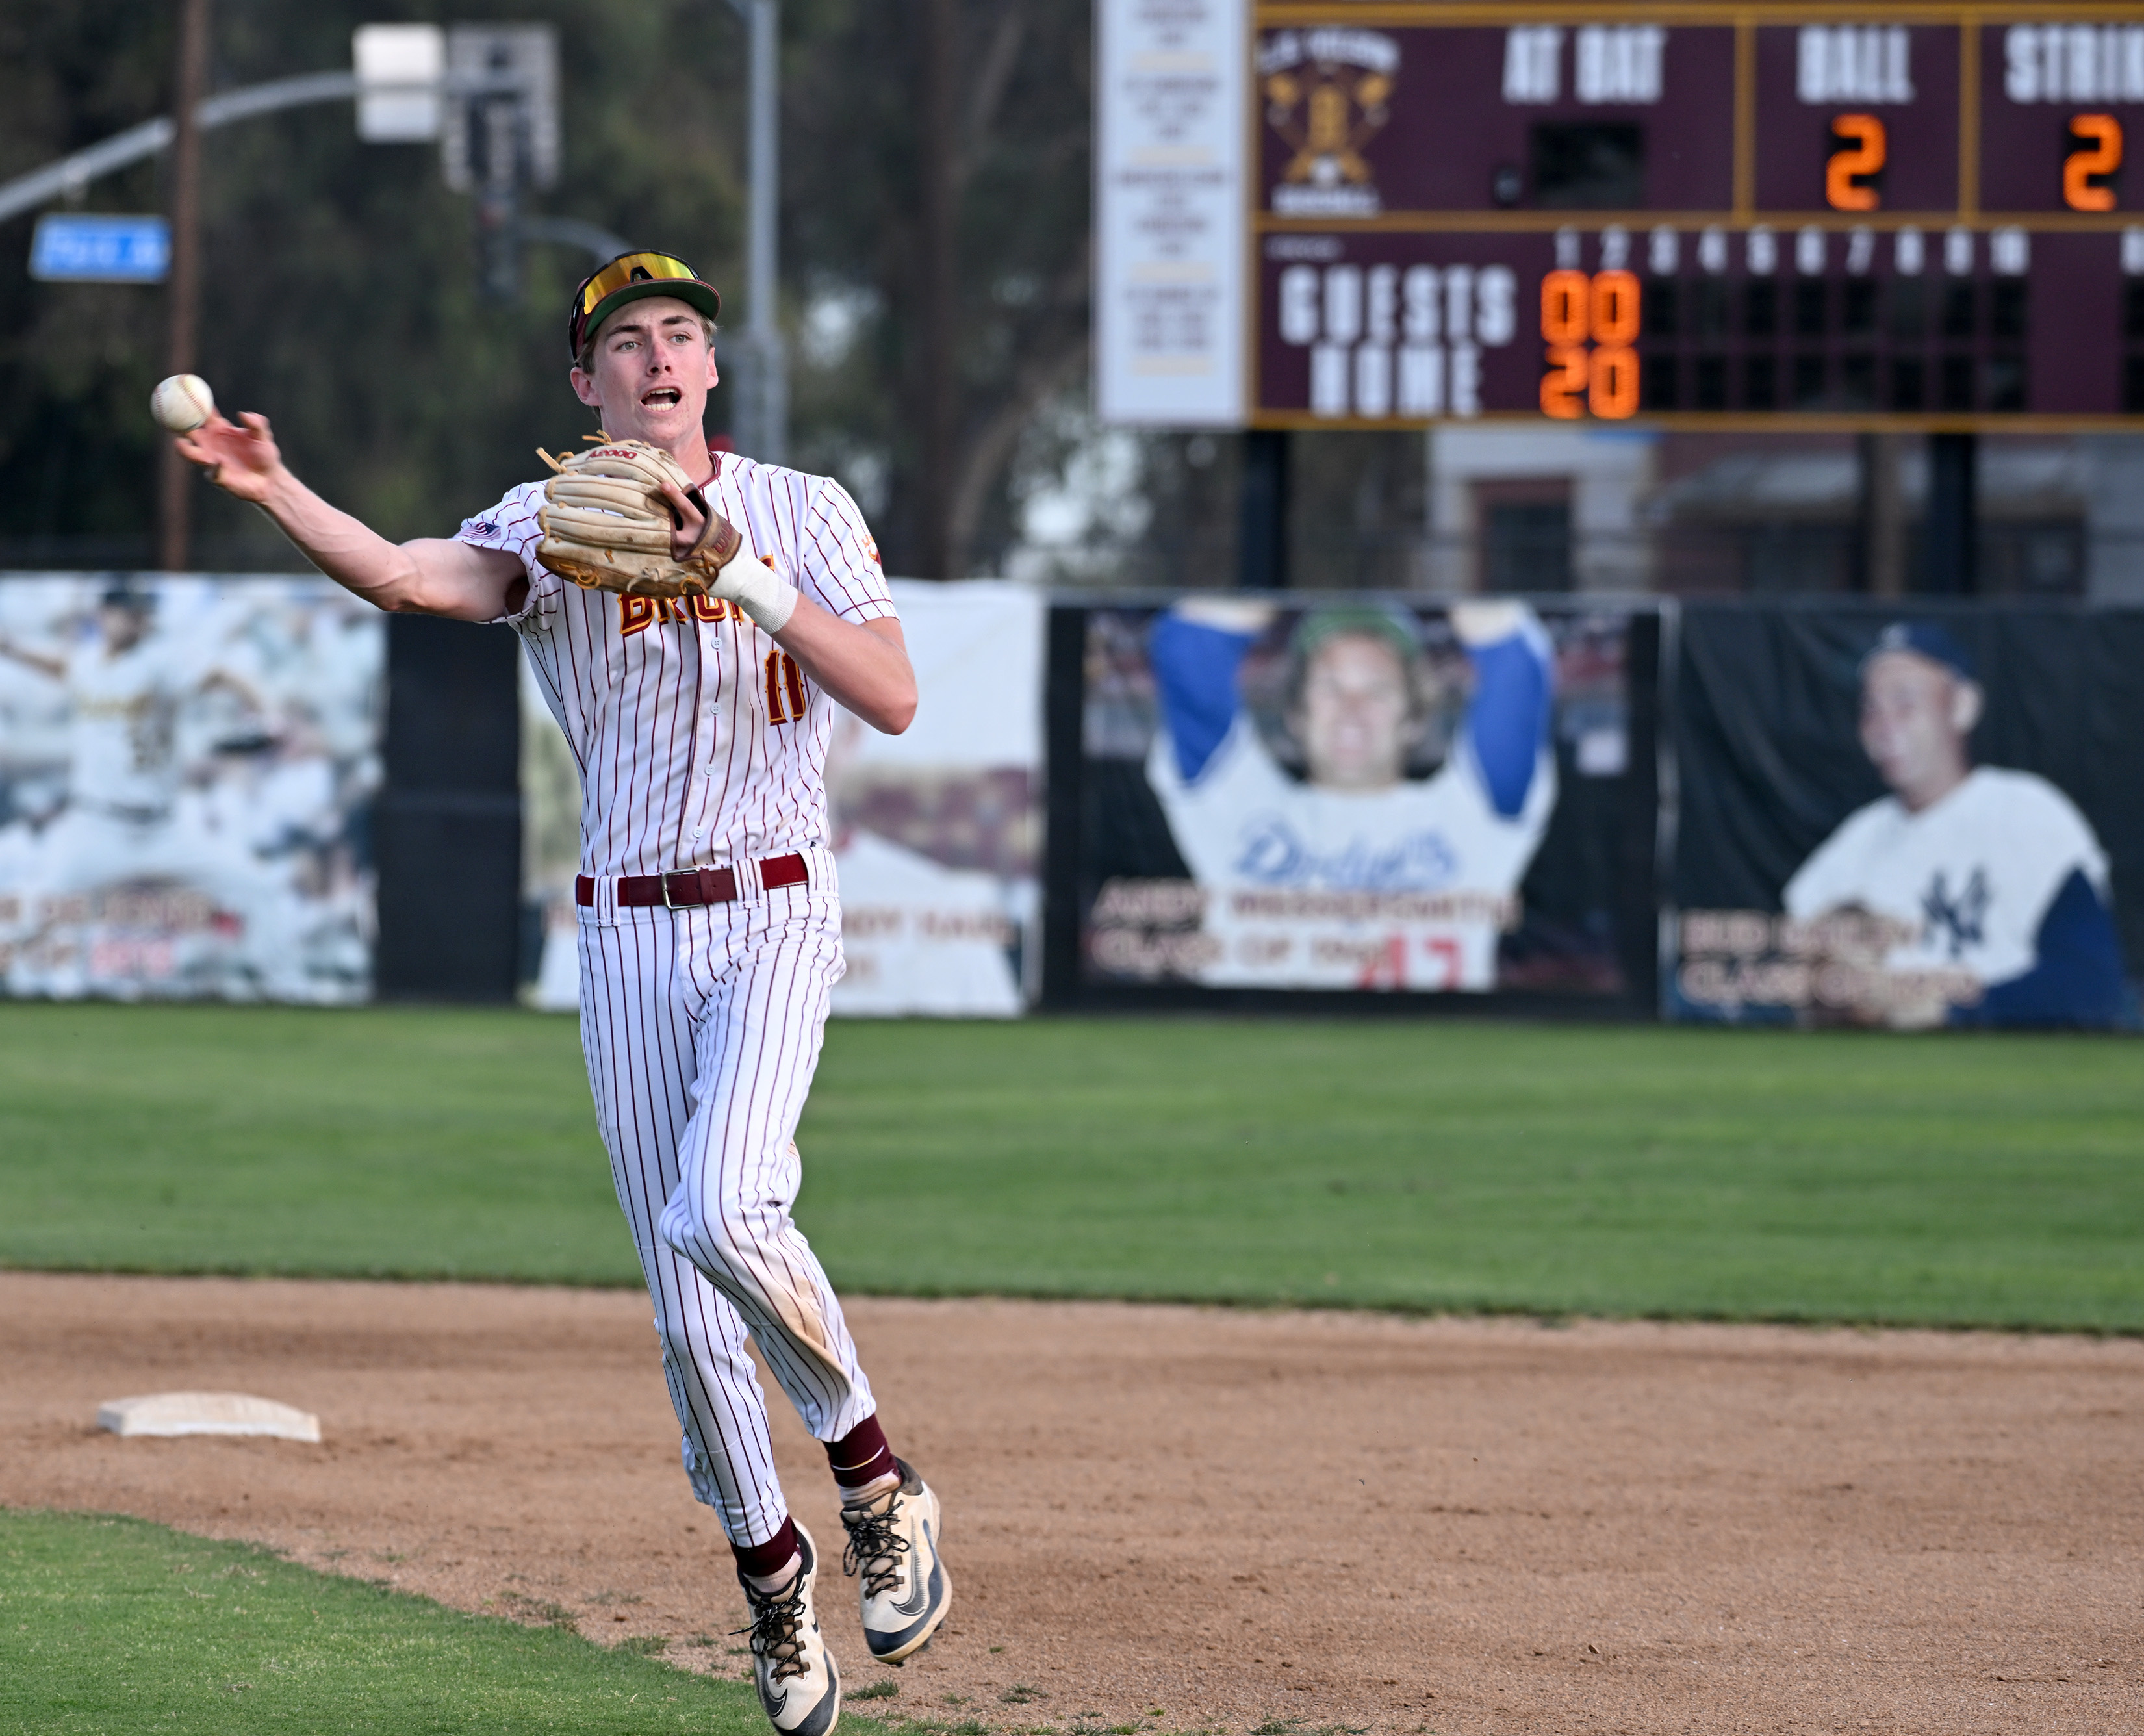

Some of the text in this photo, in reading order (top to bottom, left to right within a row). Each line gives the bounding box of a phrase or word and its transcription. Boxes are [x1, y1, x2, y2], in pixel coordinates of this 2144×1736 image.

[1502, 24, 1563, 103] AT
[1797, 25, 1915, 103] BALL
[1826, 114, 1886, 211] 2
[2063, 114, 2123, 211] 2
[1600, 226, 1629, 270] 2
[1649, 225, 1678, 275] 3
[1747, 225, 1778, 275] 5
[1846, 225, 1875, 275] 7
[1279, 264, 1517, 345] GUESTS
[1309, 340, 1479, 419] HOME
[763, 648, 808, 726] 11
